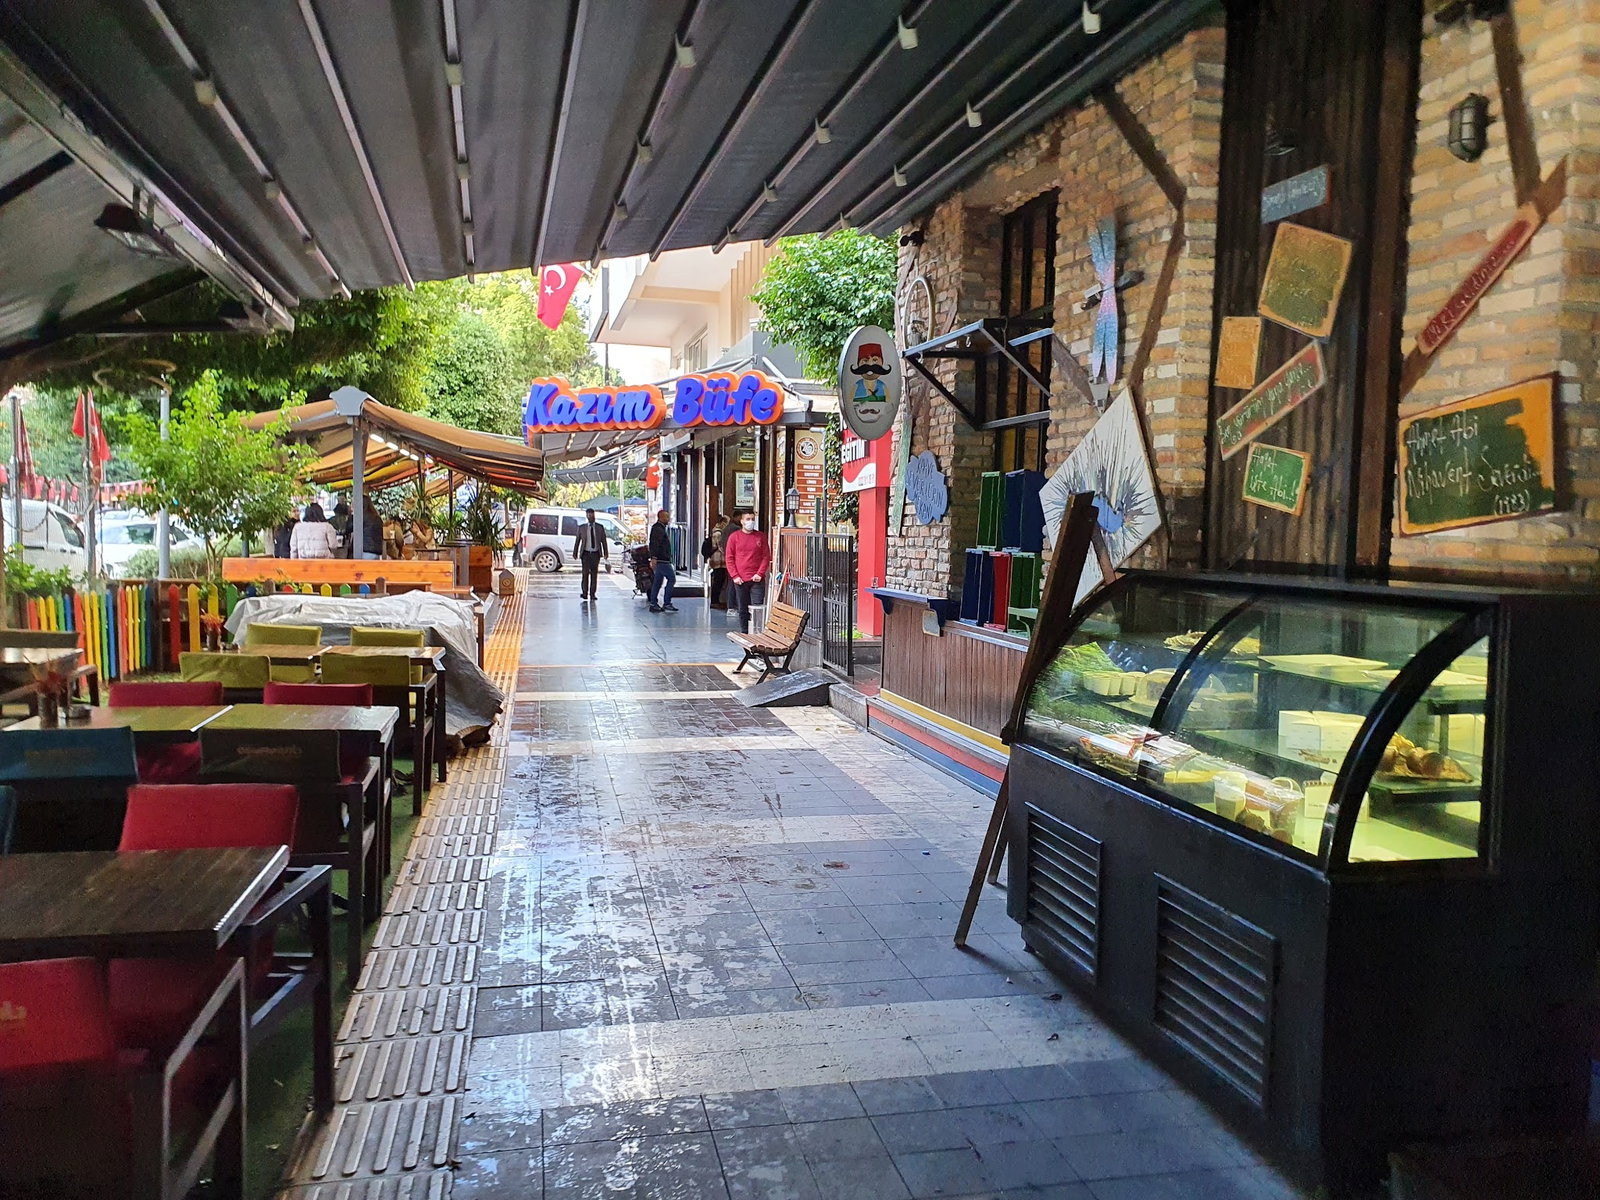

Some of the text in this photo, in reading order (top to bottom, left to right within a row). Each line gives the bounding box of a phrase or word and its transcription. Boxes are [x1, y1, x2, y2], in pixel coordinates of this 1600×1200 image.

[525, 383, 656, 426] Kazım
[672, 375, 778, 425] Büfe
[1450, 409, 1478, 447] Abi
